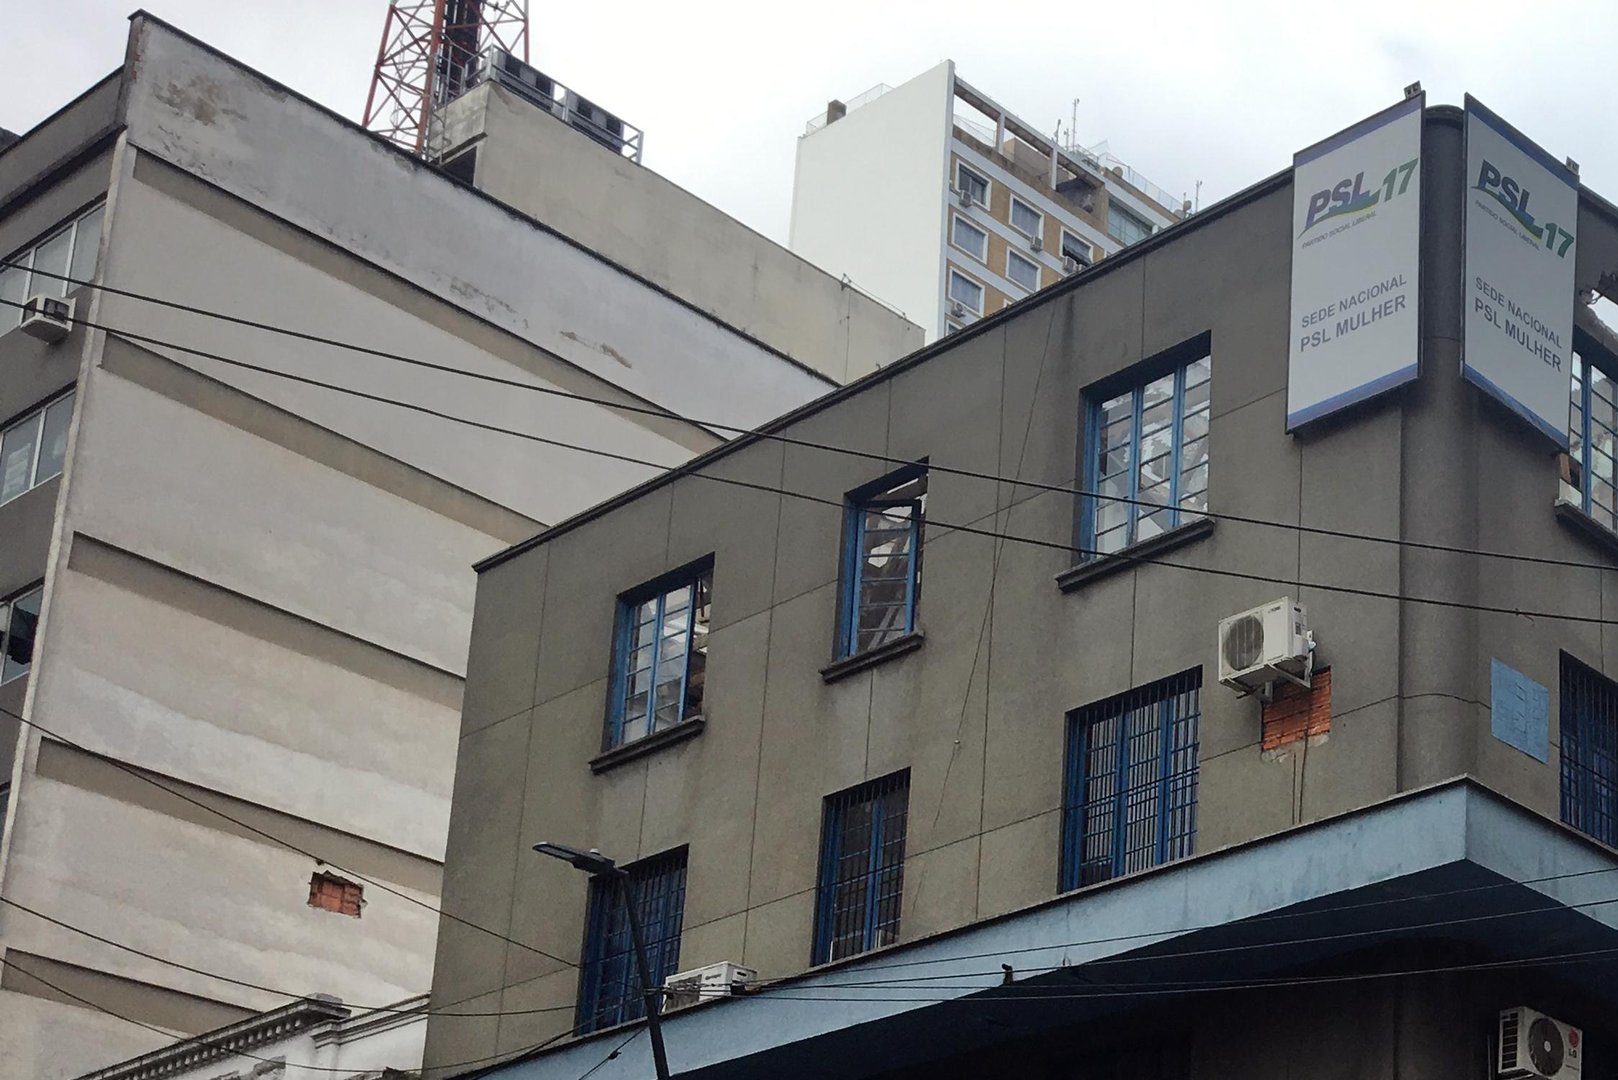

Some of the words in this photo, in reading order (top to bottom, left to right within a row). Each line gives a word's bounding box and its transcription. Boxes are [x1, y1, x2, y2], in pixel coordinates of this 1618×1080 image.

[1304, 171, 1380, 231] PSL
[1382, 158, 1418, 203] 17
[1477, 159, 1543, 238] PSL
[1544, 222, 1574, 258] 17
[1300, 330, 1331, 352] PSL
[1336, 295, 1407, 338] MULHER
[1302, 304, 1335, 328] SEDE
[1339, 274, 1407, 312] NACIONAL
[1475, 277, 1504, 307] SEDE
[1507, 303, 1562, 349] NACIONAL
[1475, 297, 1501, 329] PSL
[1505, 320, 1561, 372] MULHER
